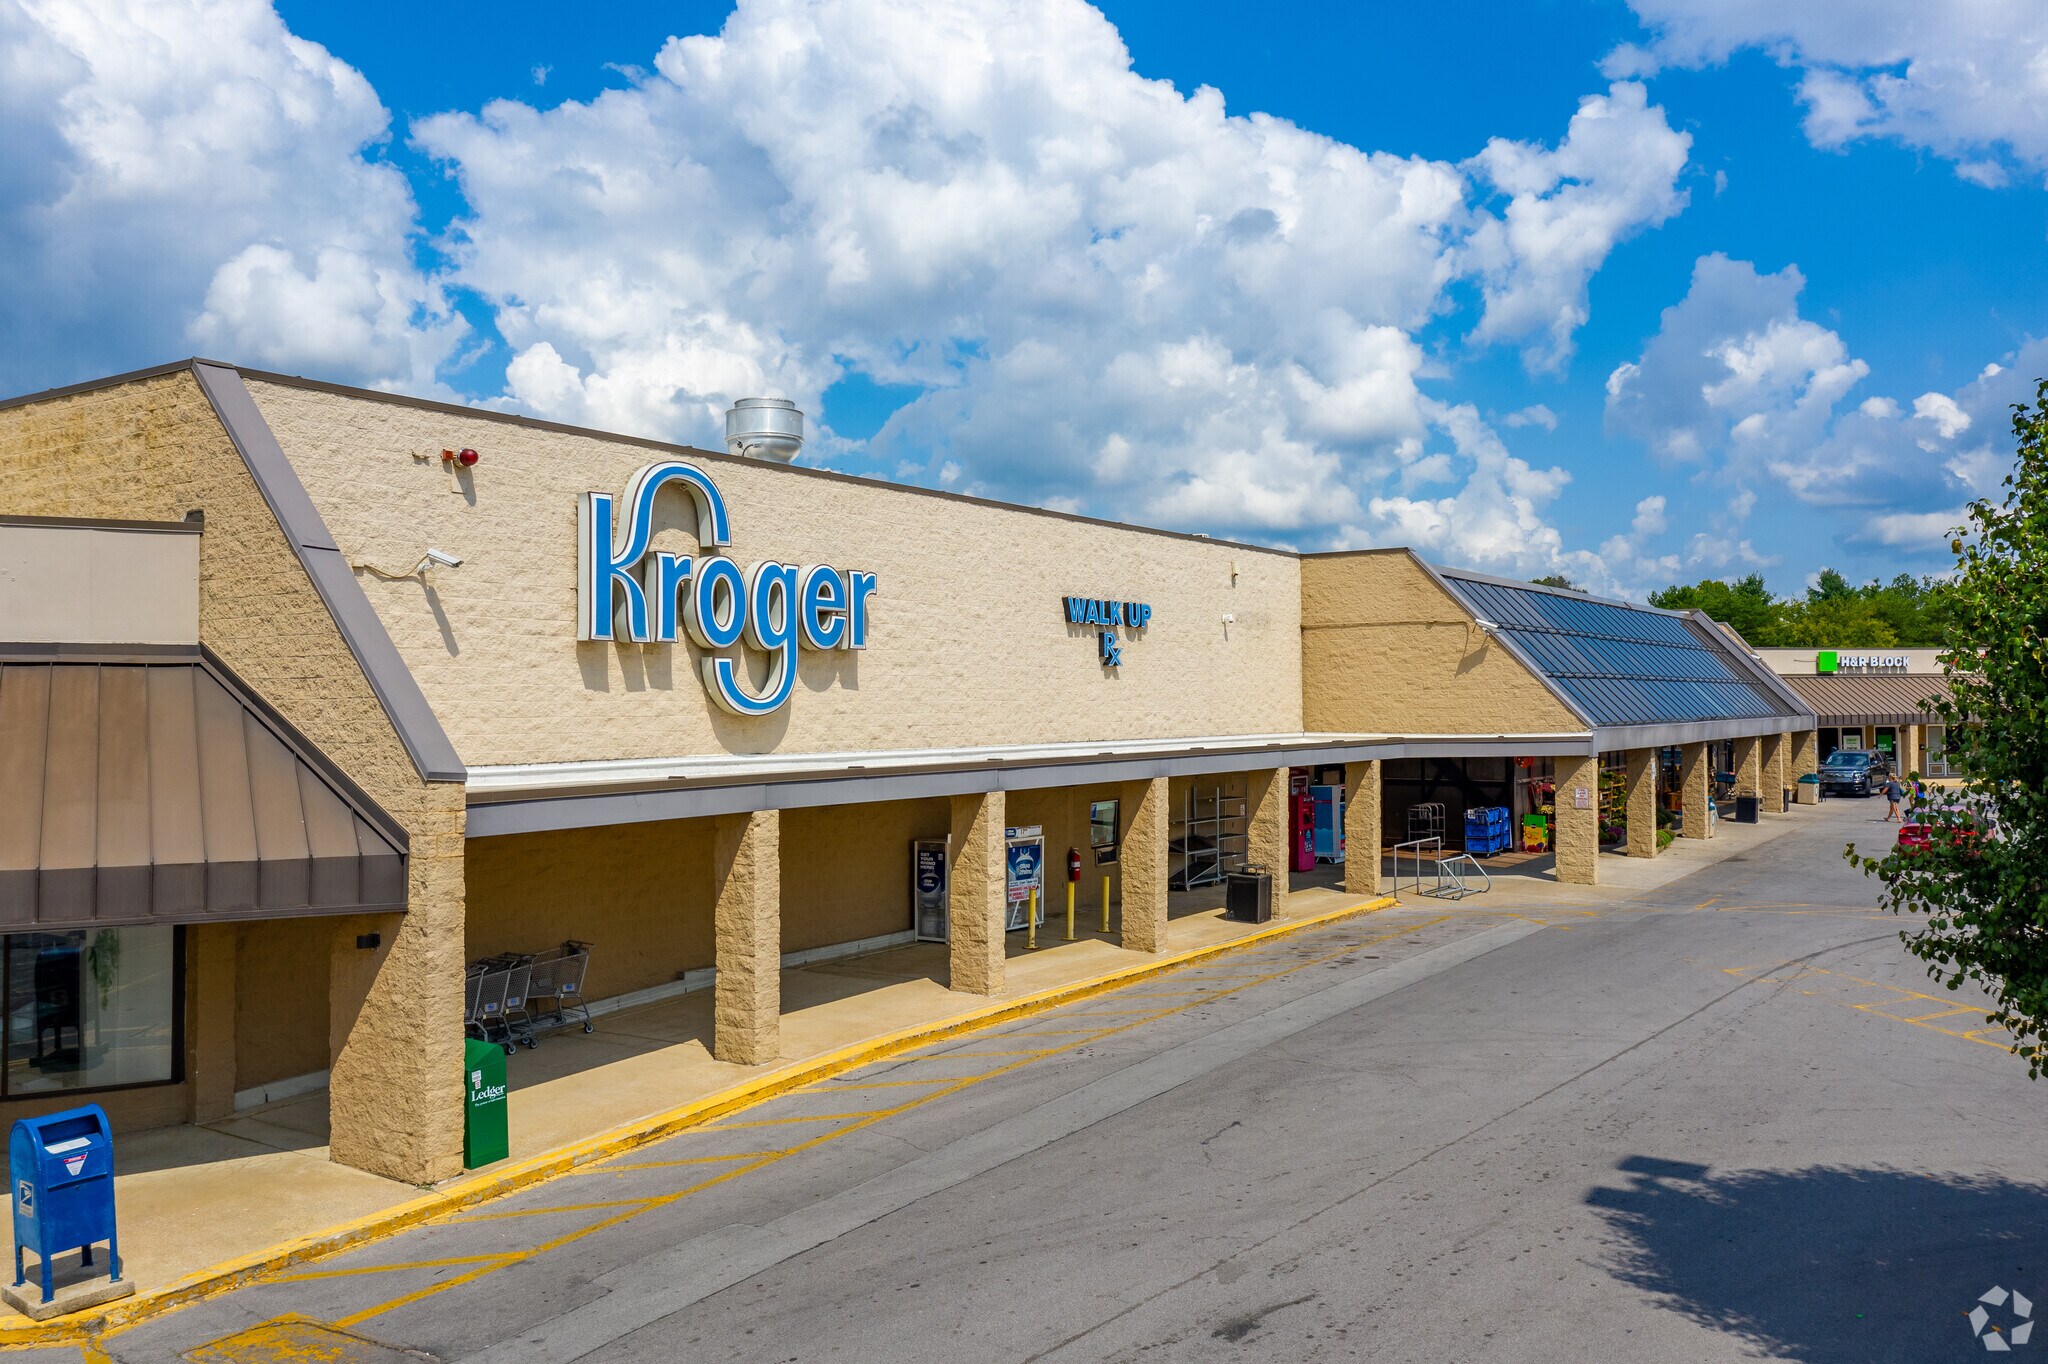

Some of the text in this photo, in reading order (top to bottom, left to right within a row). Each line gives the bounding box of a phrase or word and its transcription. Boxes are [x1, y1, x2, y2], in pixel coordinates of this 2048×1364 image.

[578, 461, 877, 716] Kroger
[1064, 597, 1152, 628] WALK UP
[1840, 656, 1910, 667] H&R BLOCK
[471, 1084, 506, 1102] Ledger
